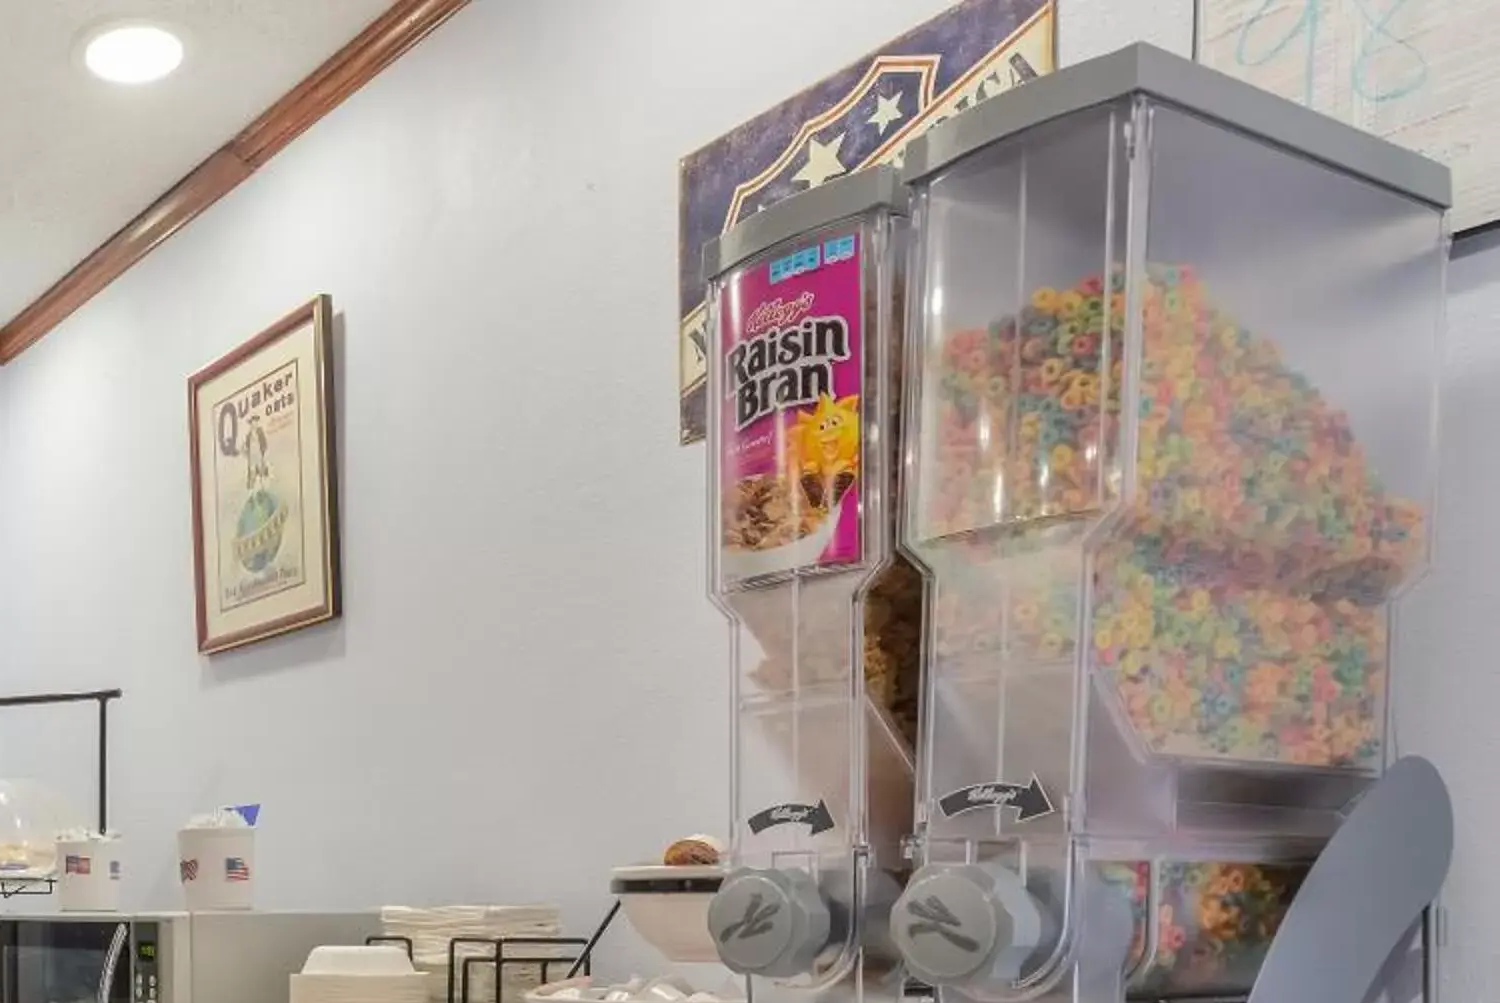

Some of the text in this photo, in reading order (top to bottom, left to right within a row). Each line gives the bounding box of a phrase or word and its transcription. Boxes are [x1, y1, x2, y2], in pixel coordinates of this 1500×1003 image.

[746, 291, 815, 333] Kellogg's
[727, 318, 846, 394] Raisin
[218, 371, 293, 457] Quaker
[265, 392, 294, 416] oats
[737, 362, 830, 426] Bran
